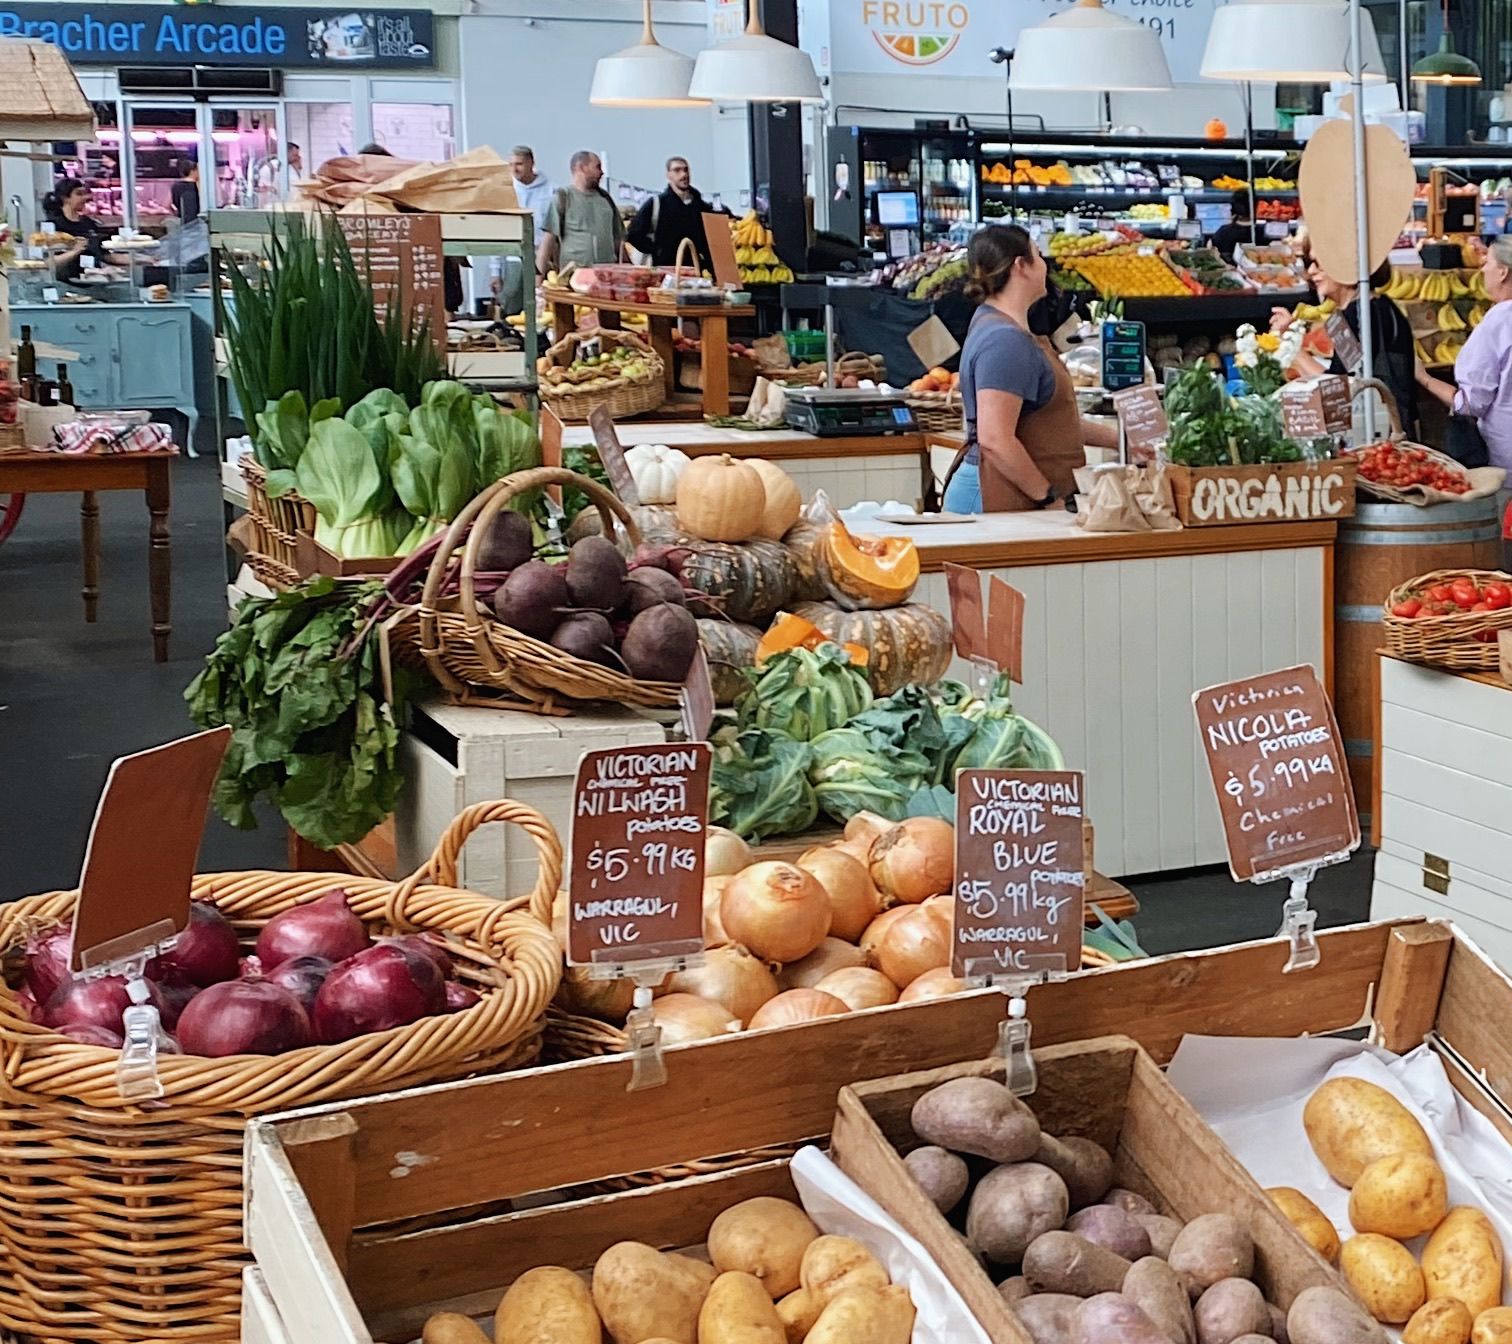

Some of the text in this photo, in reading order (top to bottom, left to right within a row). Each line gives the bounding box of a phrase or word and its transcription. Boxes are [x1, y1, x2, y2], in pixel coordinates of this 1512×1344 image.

[862, 0, 969, 29] FRUTO
[156, 14, 286, 54] Arcade
[1192, 473, 1344, 520] ORGANIC
[1208, 708, 1312, 750] NICOLA
[1258, 726, 1330, 759] POTATOES
[596, 750, 697, 778] VICTORIAN
[577, 784, 685, 816] WILWASH
[972, 774, 1079, 803] VICTORIAN
[970, 805, 1046, 837] ROYAL
[993, 840, 1058, 871] BLUE
[600, 922, 640, 945] VIC
[993, 946, 1031, 969] VIC
